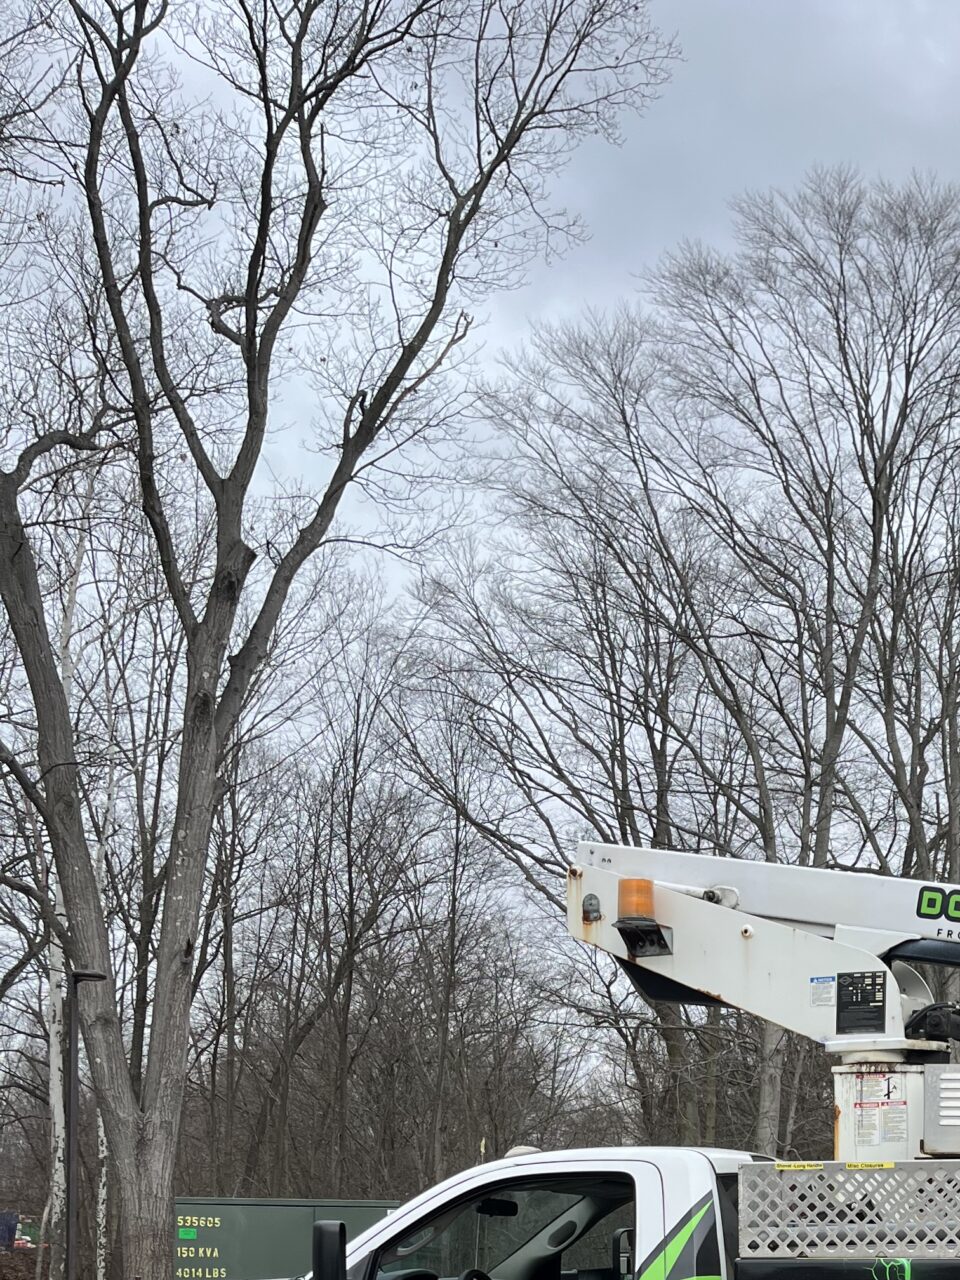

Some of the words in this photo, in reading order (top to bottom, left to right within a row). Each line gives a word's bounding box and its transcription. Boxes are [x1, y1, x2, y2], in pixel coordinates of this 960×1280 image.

[177, 1216, 221, 1227] 535605
[177, 1247, 195, 1257] 150
[199, 1247, 219, 1257] KVA
[176, 1268, 202, 1278] 4014
[205, 1268, 227, 1278] LBS
